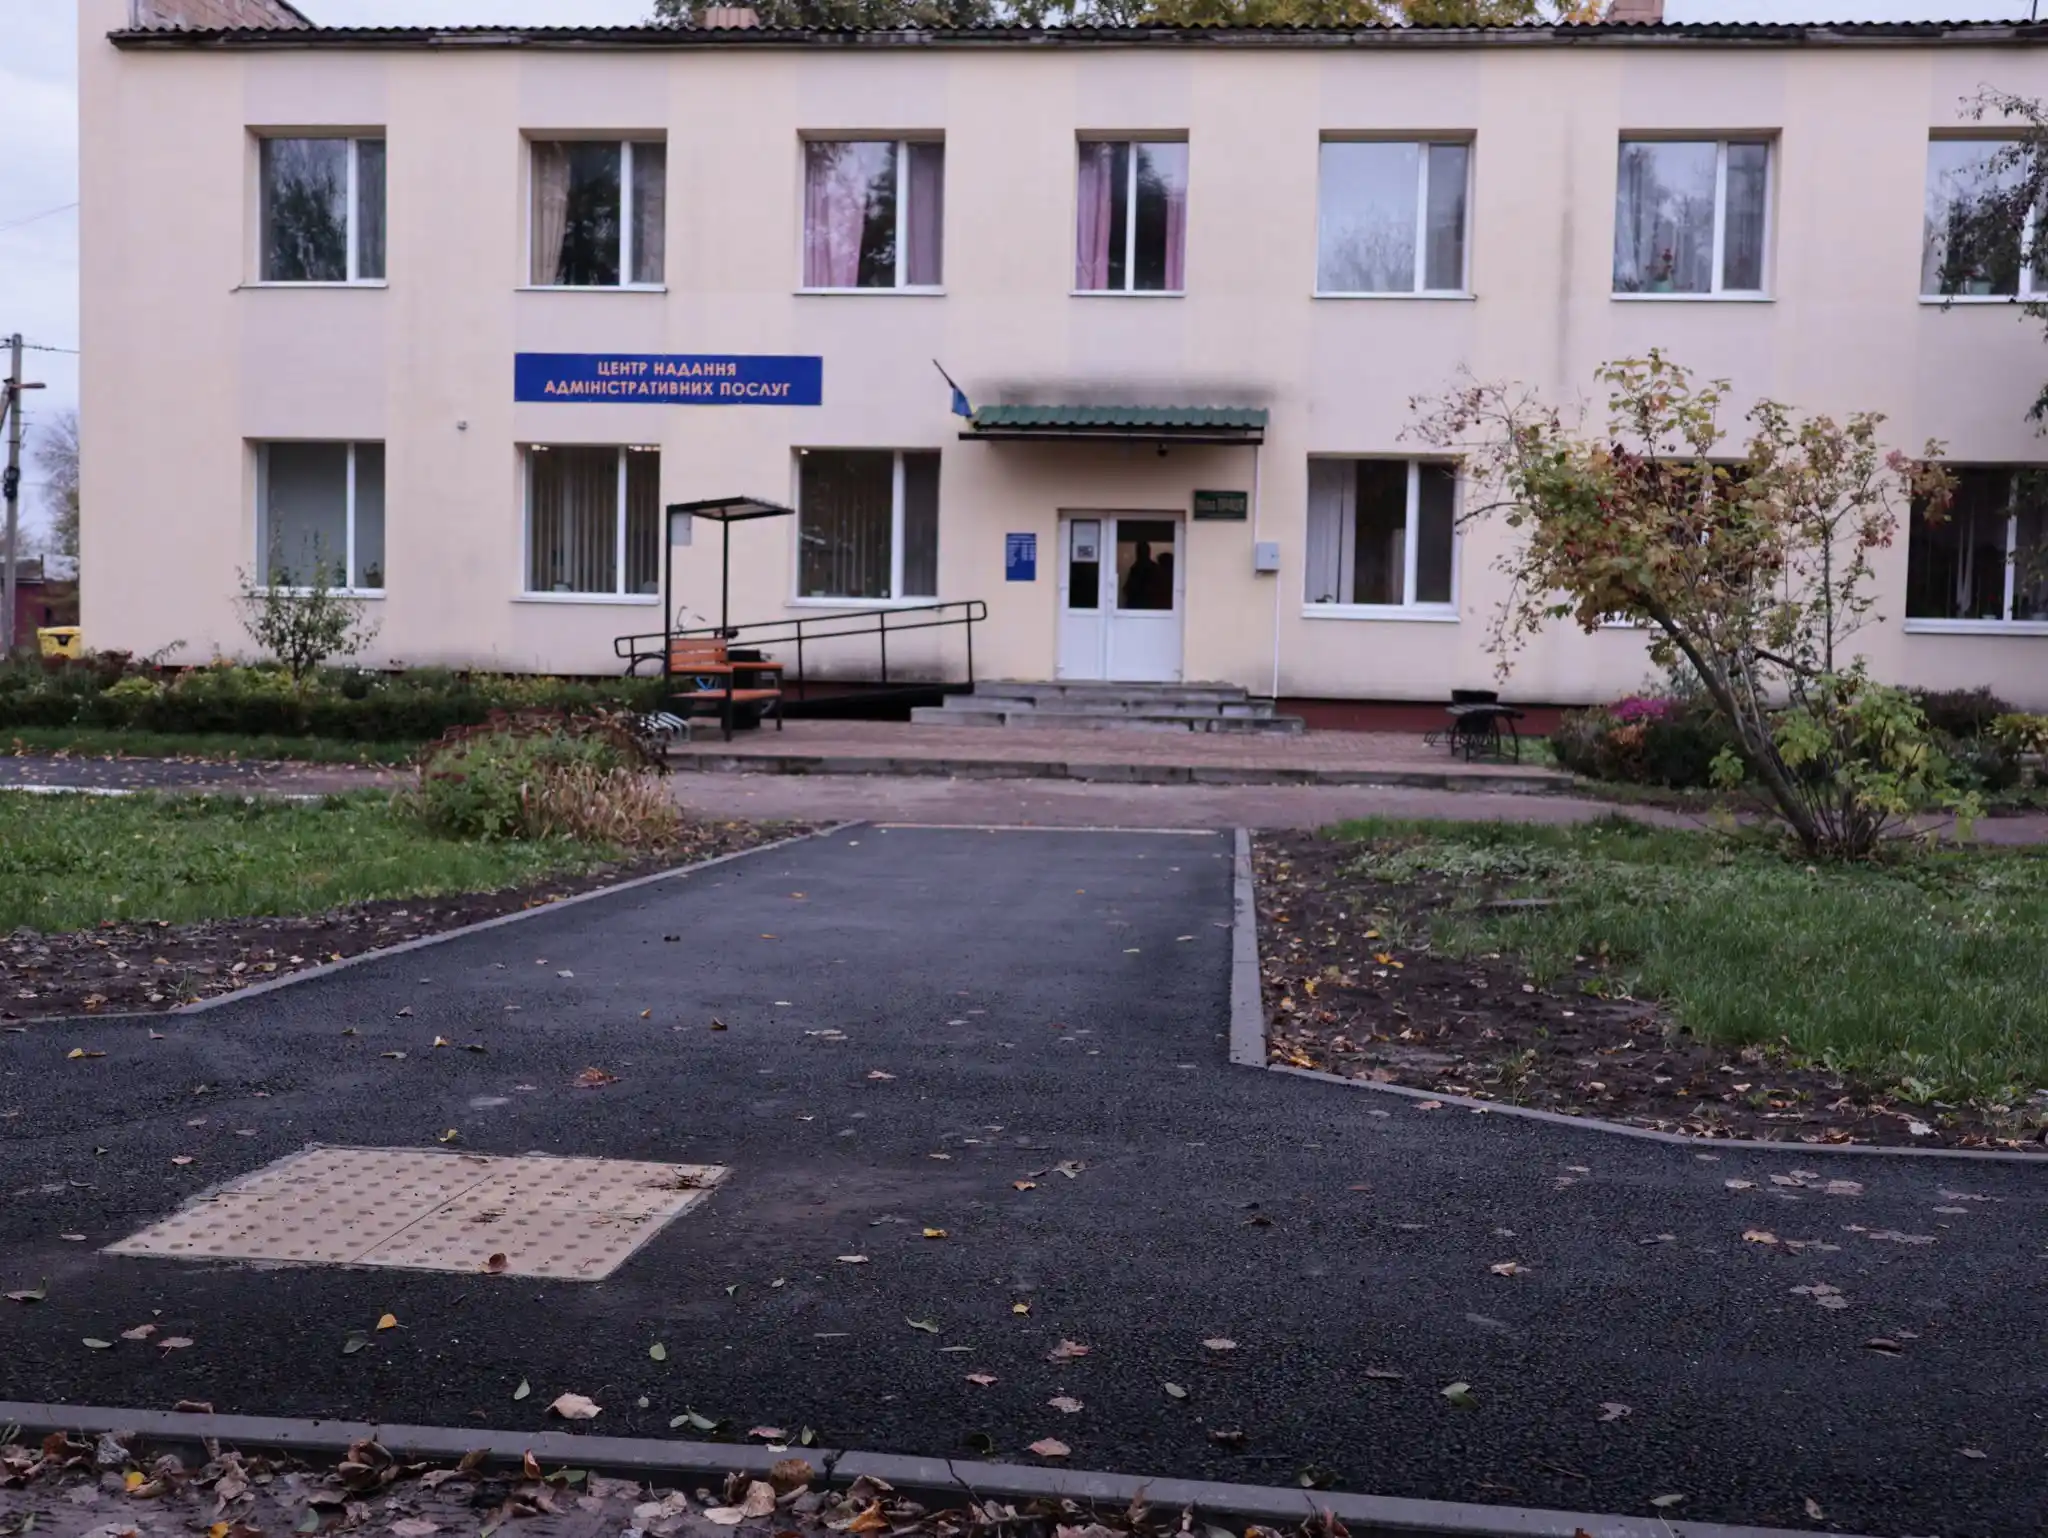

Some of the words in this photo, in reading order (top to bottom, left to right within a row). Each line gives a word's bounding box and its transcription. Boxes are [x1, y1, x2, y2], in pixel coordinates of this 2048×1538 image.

[597, 361, 647, 377] ЦЕНТР
[654, 362, 736, 376] НАДАННЯ
[544, 379, 713, 395] АДМІНІСТРАТИВНИХ
[720, 383, 790, 396] ПОСЛУГ
